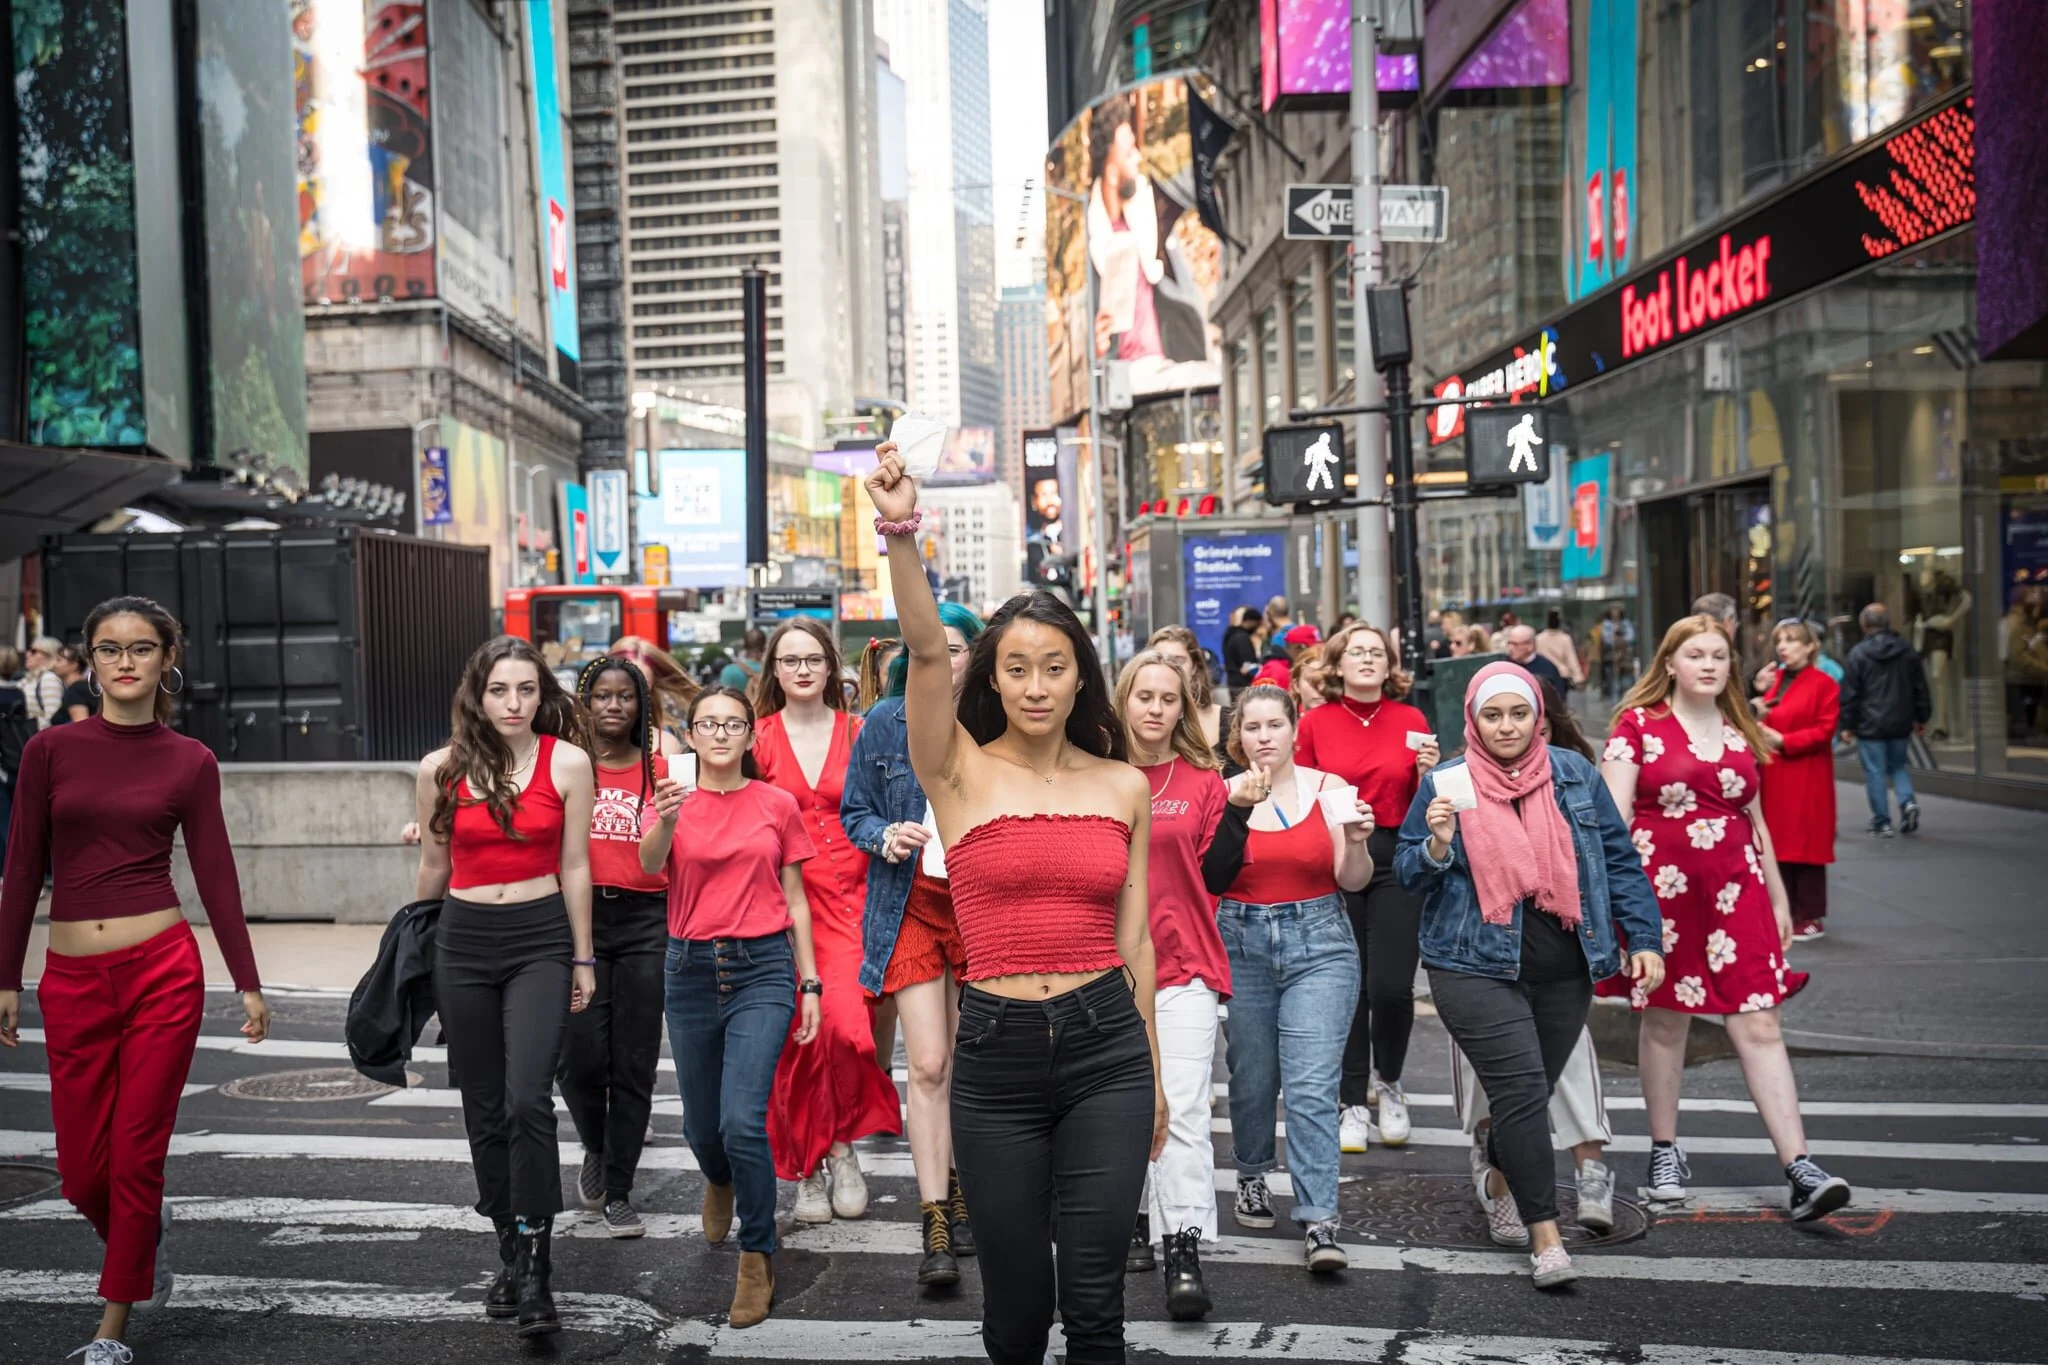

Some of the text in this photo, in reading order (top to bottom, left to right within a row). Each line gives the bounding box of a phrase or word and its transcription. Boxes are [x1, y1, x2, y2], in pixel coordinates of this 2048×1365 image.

[1311, 202, 1352, 222] ONE
[1621, 233, 1772, 358] Foot Locker
